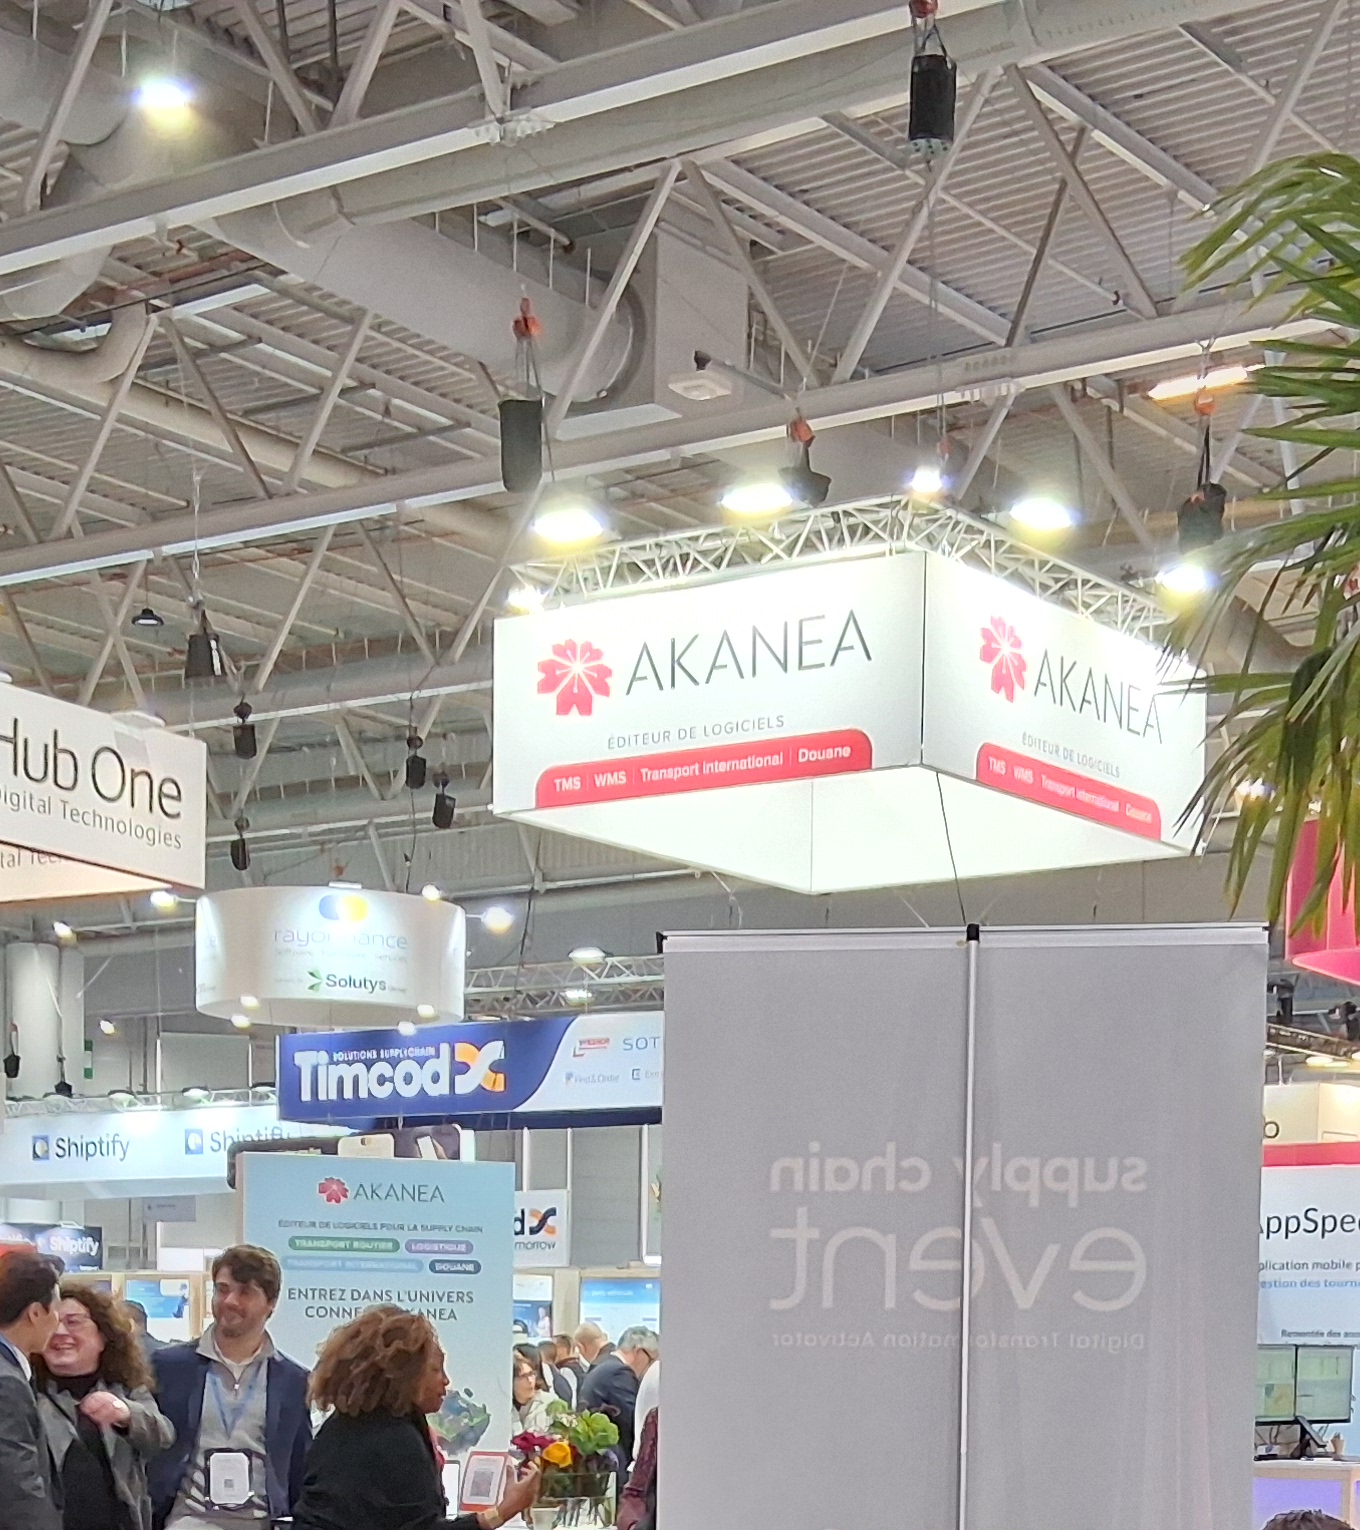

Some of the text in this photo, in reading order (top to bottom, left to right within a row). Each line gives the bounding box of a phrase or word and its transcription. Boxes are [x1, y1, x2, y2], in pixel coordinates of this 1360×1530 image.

[626, 609, 872, 696] AKANEA
[1034, 648, 1162, 744] AKANEA
[607, 715, 786, 750] ÉDITEUR DE LOGICIELS
[1063, 746, 1074, 761] DE
[554, 744, 852, 792] TMS WMS Transport International Douane
[91, 746, 181, 819] One
[61, 800, 182, 850] Technologies
[326, 974, 387, 994] Solutys
[55, 1133, 130, 1162] Shiptify
[353, 1183, 445, 1204] AKANEA
[50, 1236, 99, 1257] Shiptify
[1312, 1259, 1352, 1270] mobile
[288, 1288, 474, 1303] ENTREZ DANS L'UNIVERS
[1300, 1278, 1321, 1289] des
